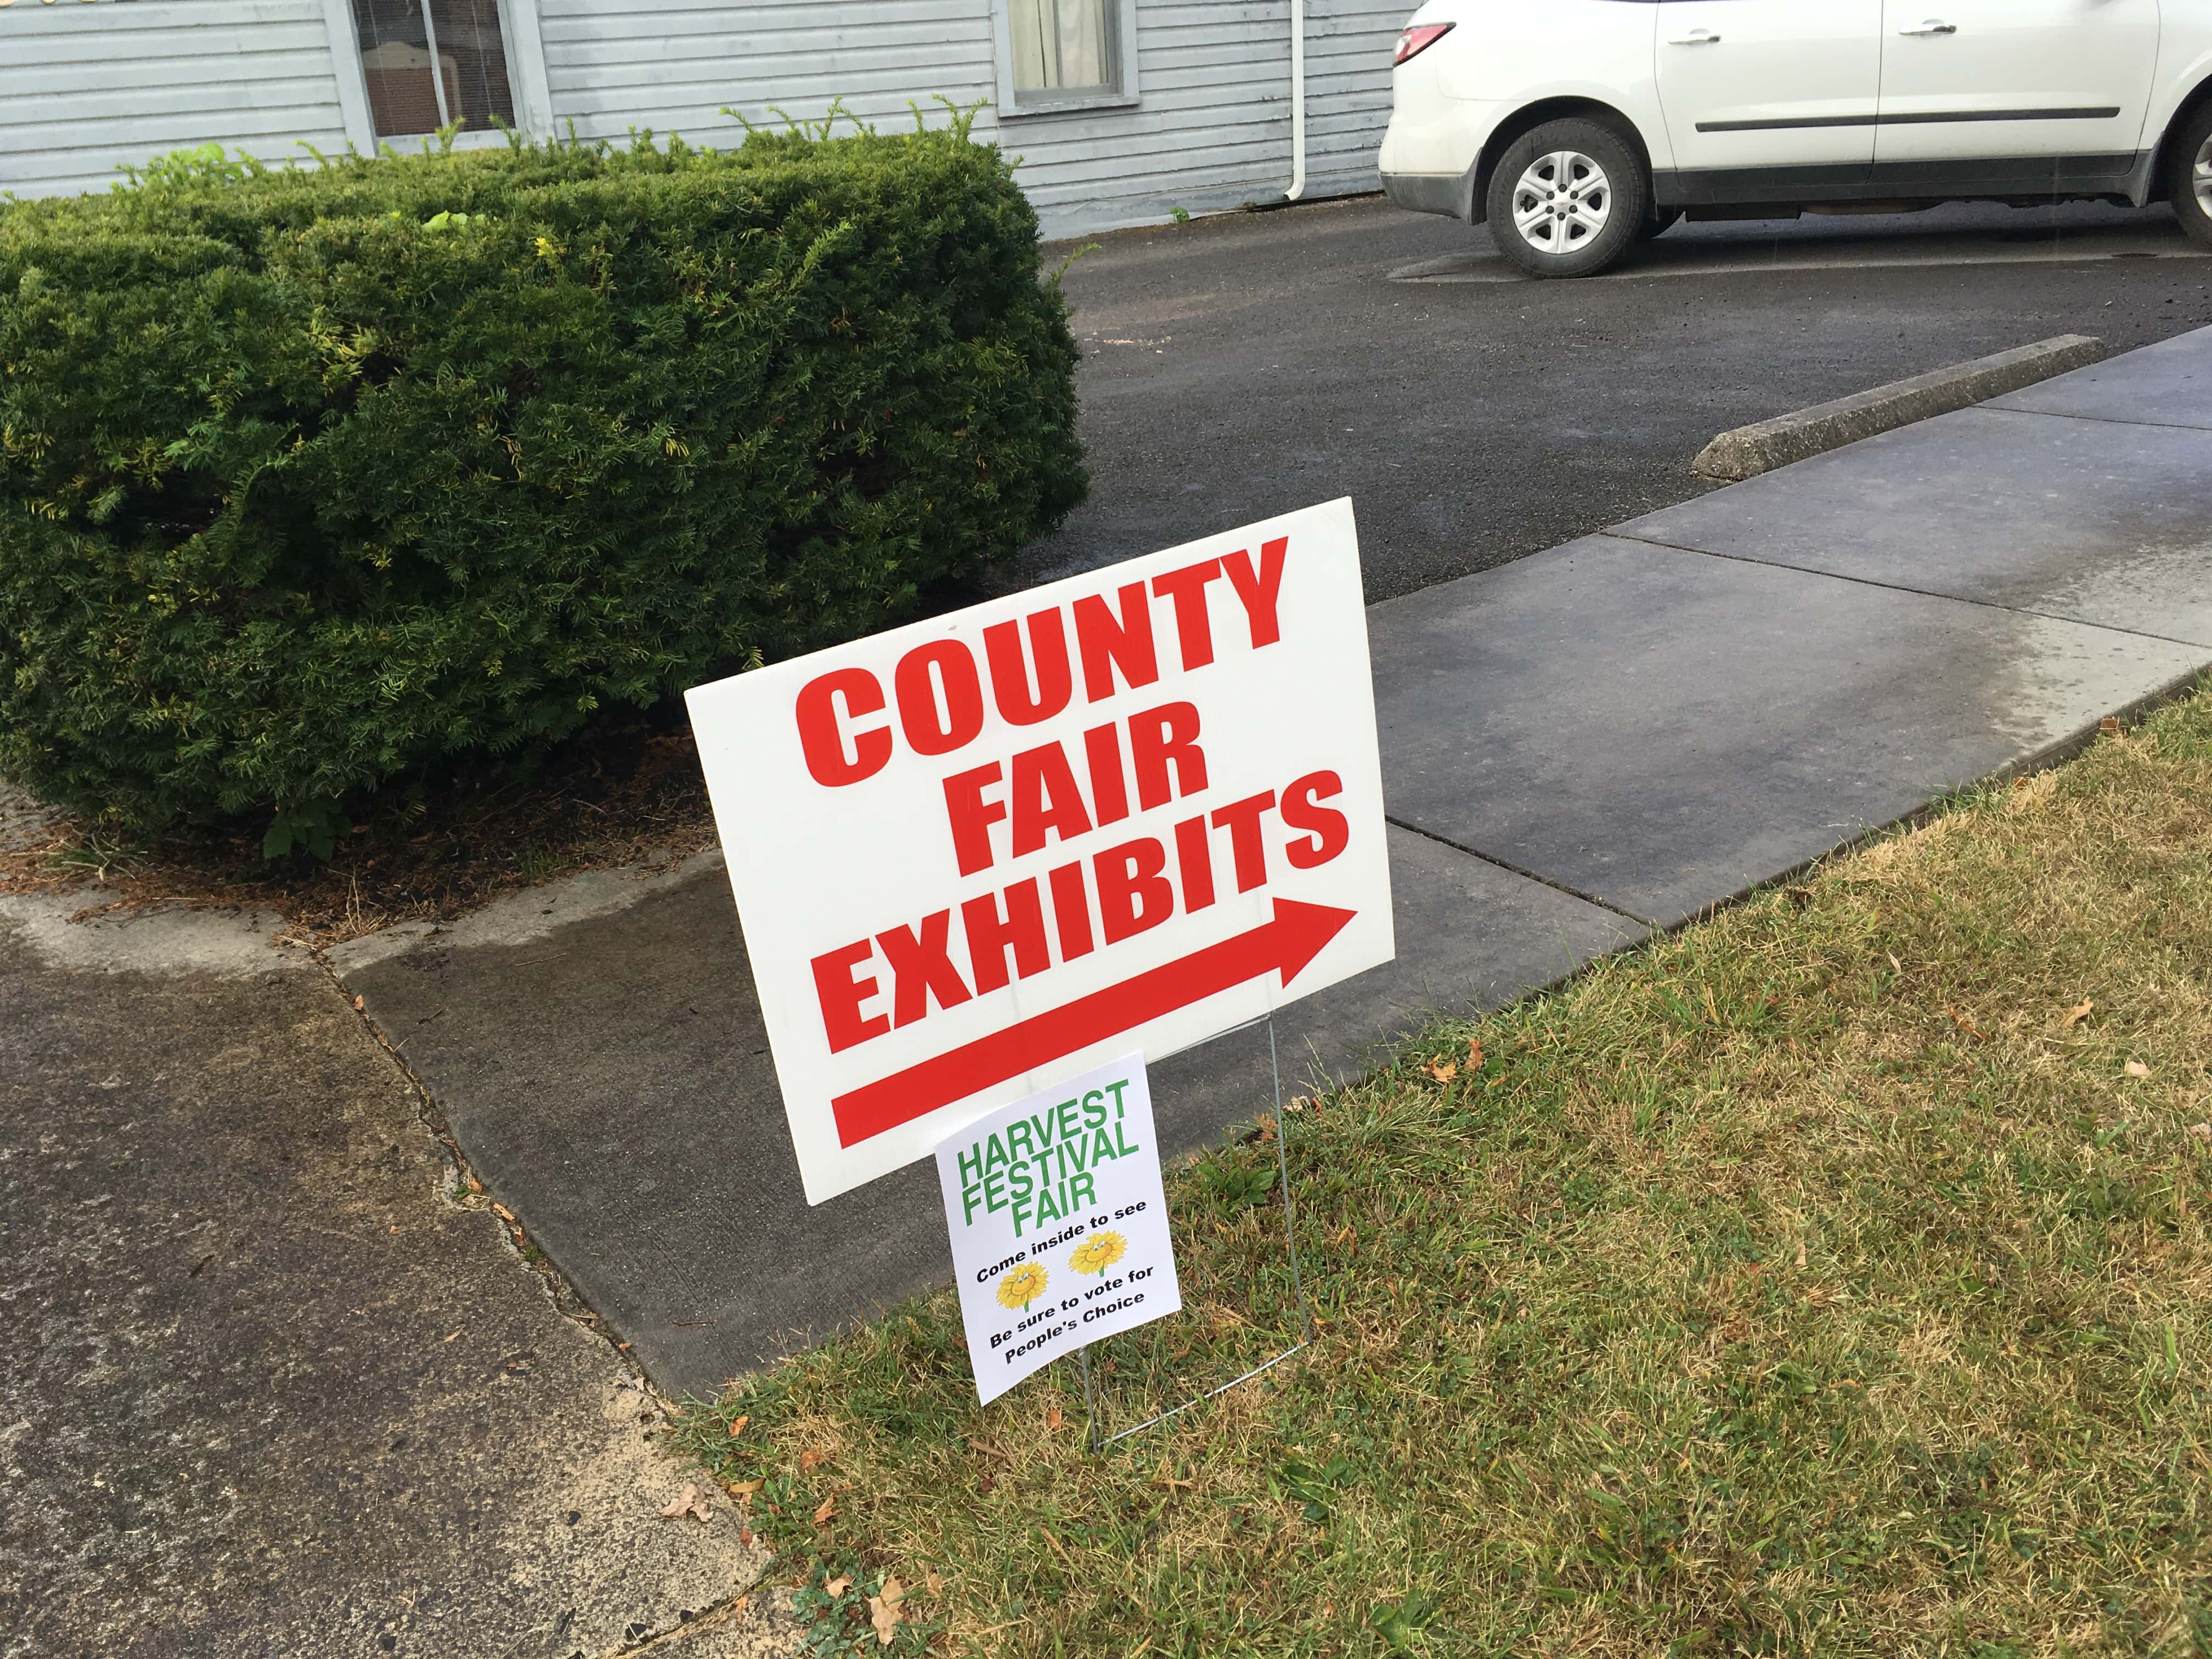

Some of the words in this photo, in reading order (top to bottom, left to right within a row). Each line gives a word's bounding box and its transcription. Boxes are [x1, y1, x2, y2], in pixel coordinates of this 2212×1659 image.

[795, 537, 1288, 787] COUNTY
[943, 702, 1208, 877] FAIR
[810, 770, 1349, 1054] EXHIBITS
[957, 1079, 1129, 1188] HARVEST
[962, 1121, 1139, 1227] FESTIVAL
[977, 1251, 1026, 1283] Come
[1031, 1224, 1085, 1256] inside
[1090, 1216, 1108, 1228] to
[1114, 1201, 1147, 1220] see
[1011, 1172, 1097, 1238] FAIR
[990, 1330, 1012, 1348] Be
[1017, 1307, 1056, 1332] sure
[1060, 1297, 1079, 1311] to
[1084, 1278, 1124, 1300] vote
[1128, 1266, 1154, 1283] for
[1005, 1319, 1077, 1364] People's
[1083, 1293, 1145, 1323] Choice
